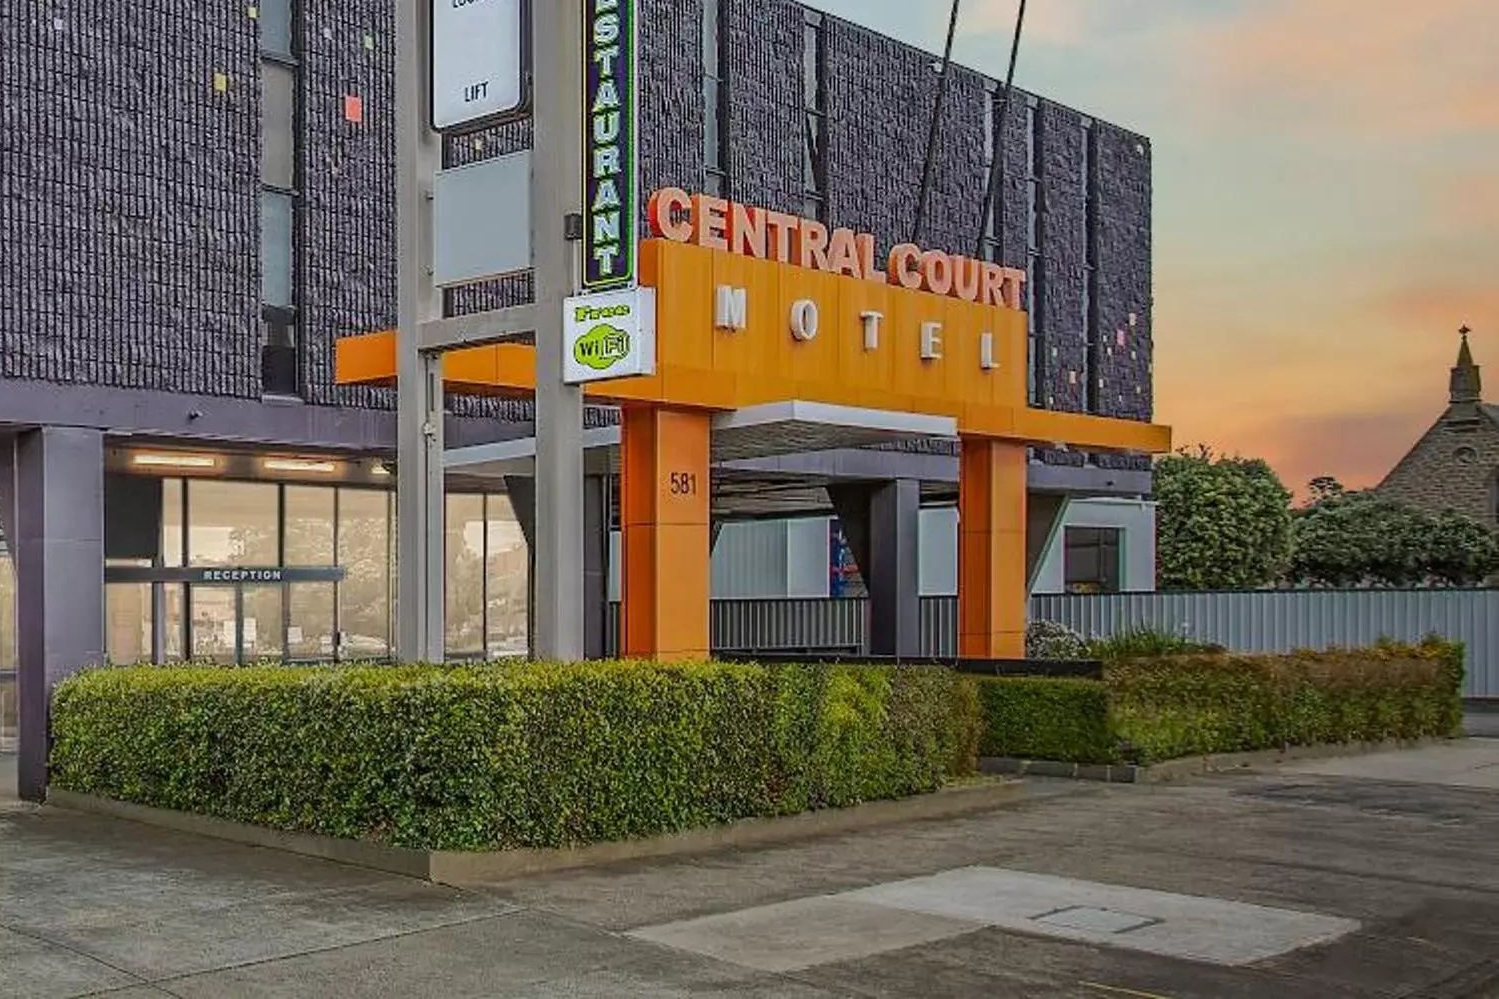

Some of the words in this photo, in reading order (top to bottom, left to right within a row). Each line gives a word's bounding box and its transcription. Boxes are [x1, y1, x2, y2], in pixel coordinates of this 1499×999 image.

[464, 81, 489, 102] LIFT
[648, 186, 887, 284] CENTRAL
[888, 242, 1027, 311] COURT
[716, 284, 1001, 370] MOTEL
[670, 472, 697, 496] 581
[203, 570, 281, 580] RECEPTION
